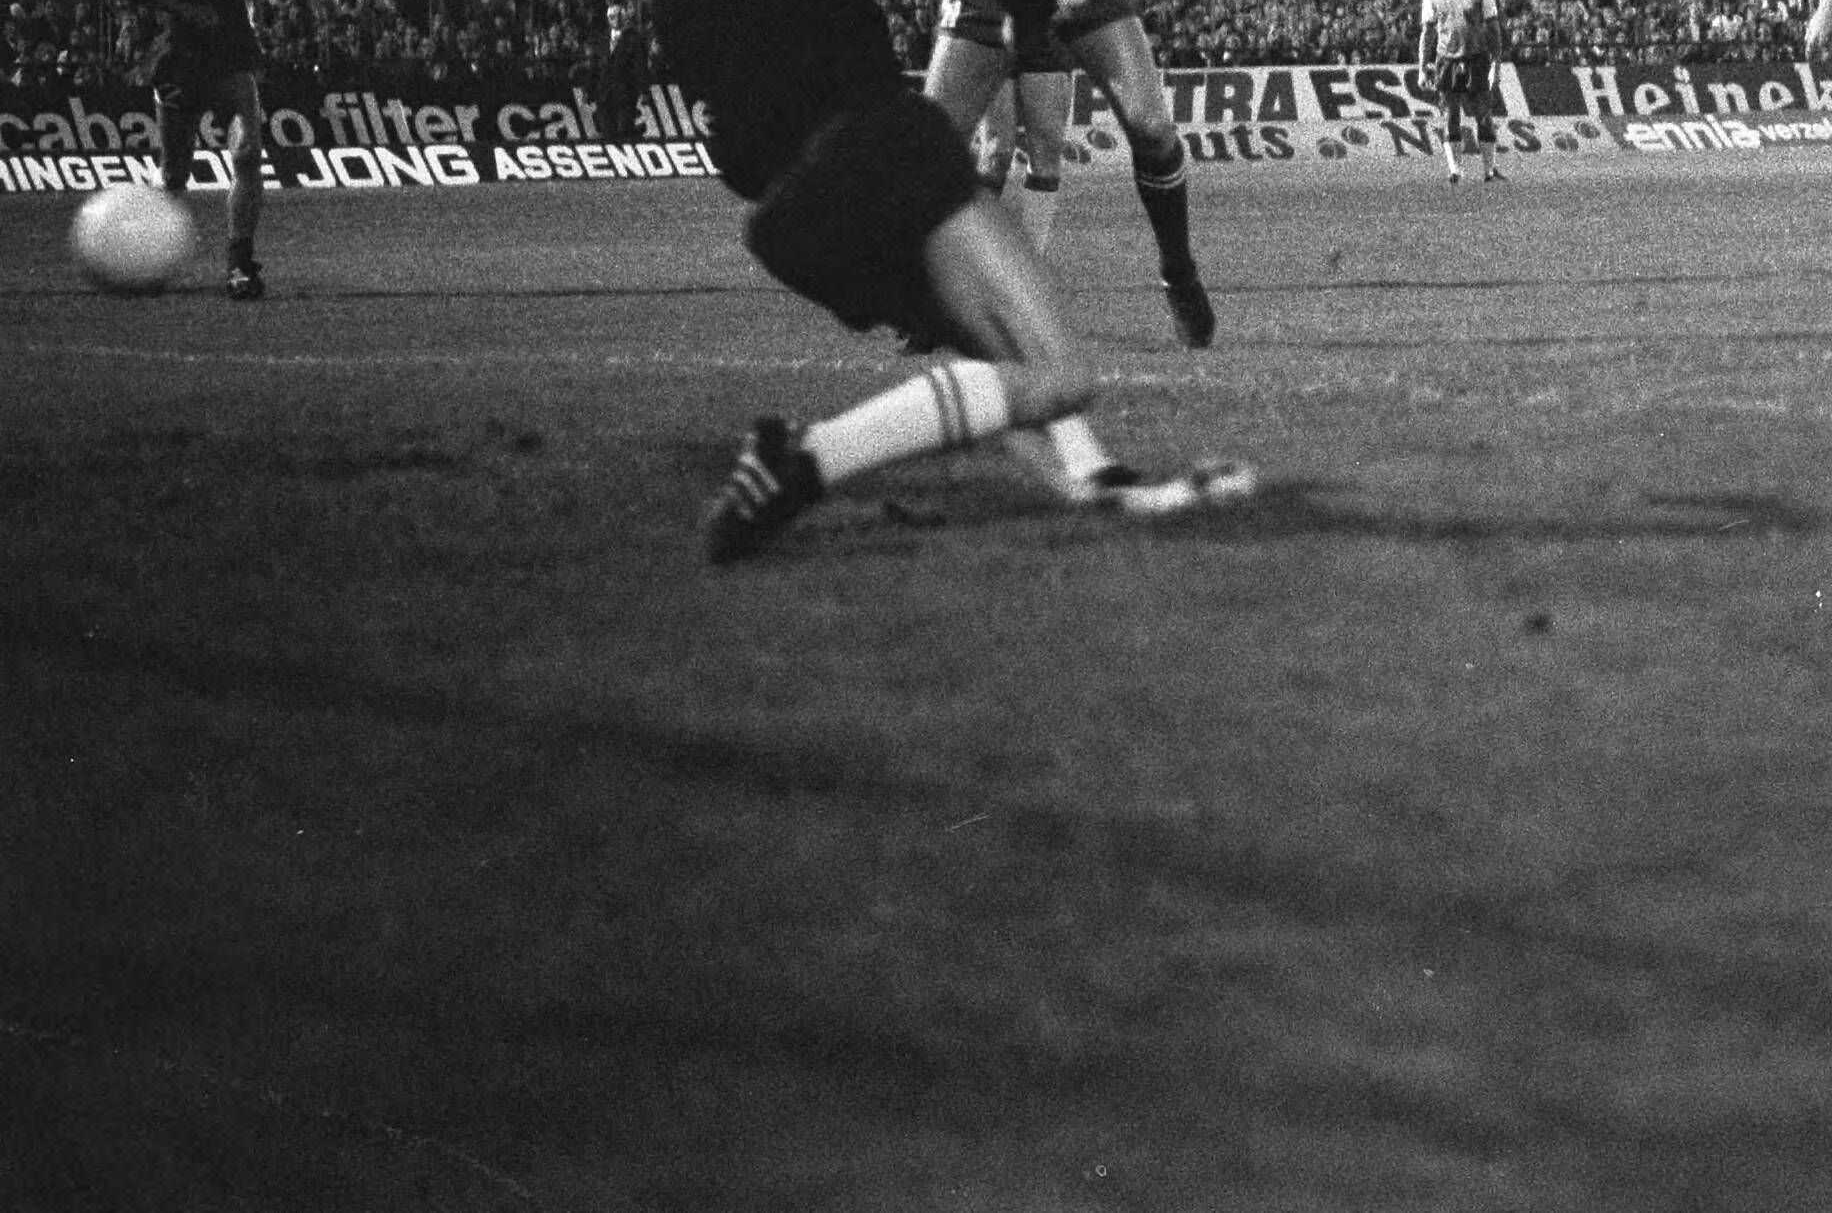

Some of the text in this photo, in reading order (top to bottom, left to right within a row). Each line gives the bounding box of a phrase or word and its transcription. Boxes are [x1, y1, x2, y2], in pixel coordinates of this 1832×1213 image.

[0, 96, 315, 150] cabaeo
[320, 92, 480, 145] filter
[1623, 114, 1761, 149] ennia
[1183, 124, 1296, 162] uts
[296, 144, 480, 188] JONG
[494, 141, 724, 181] ASSENDEL
